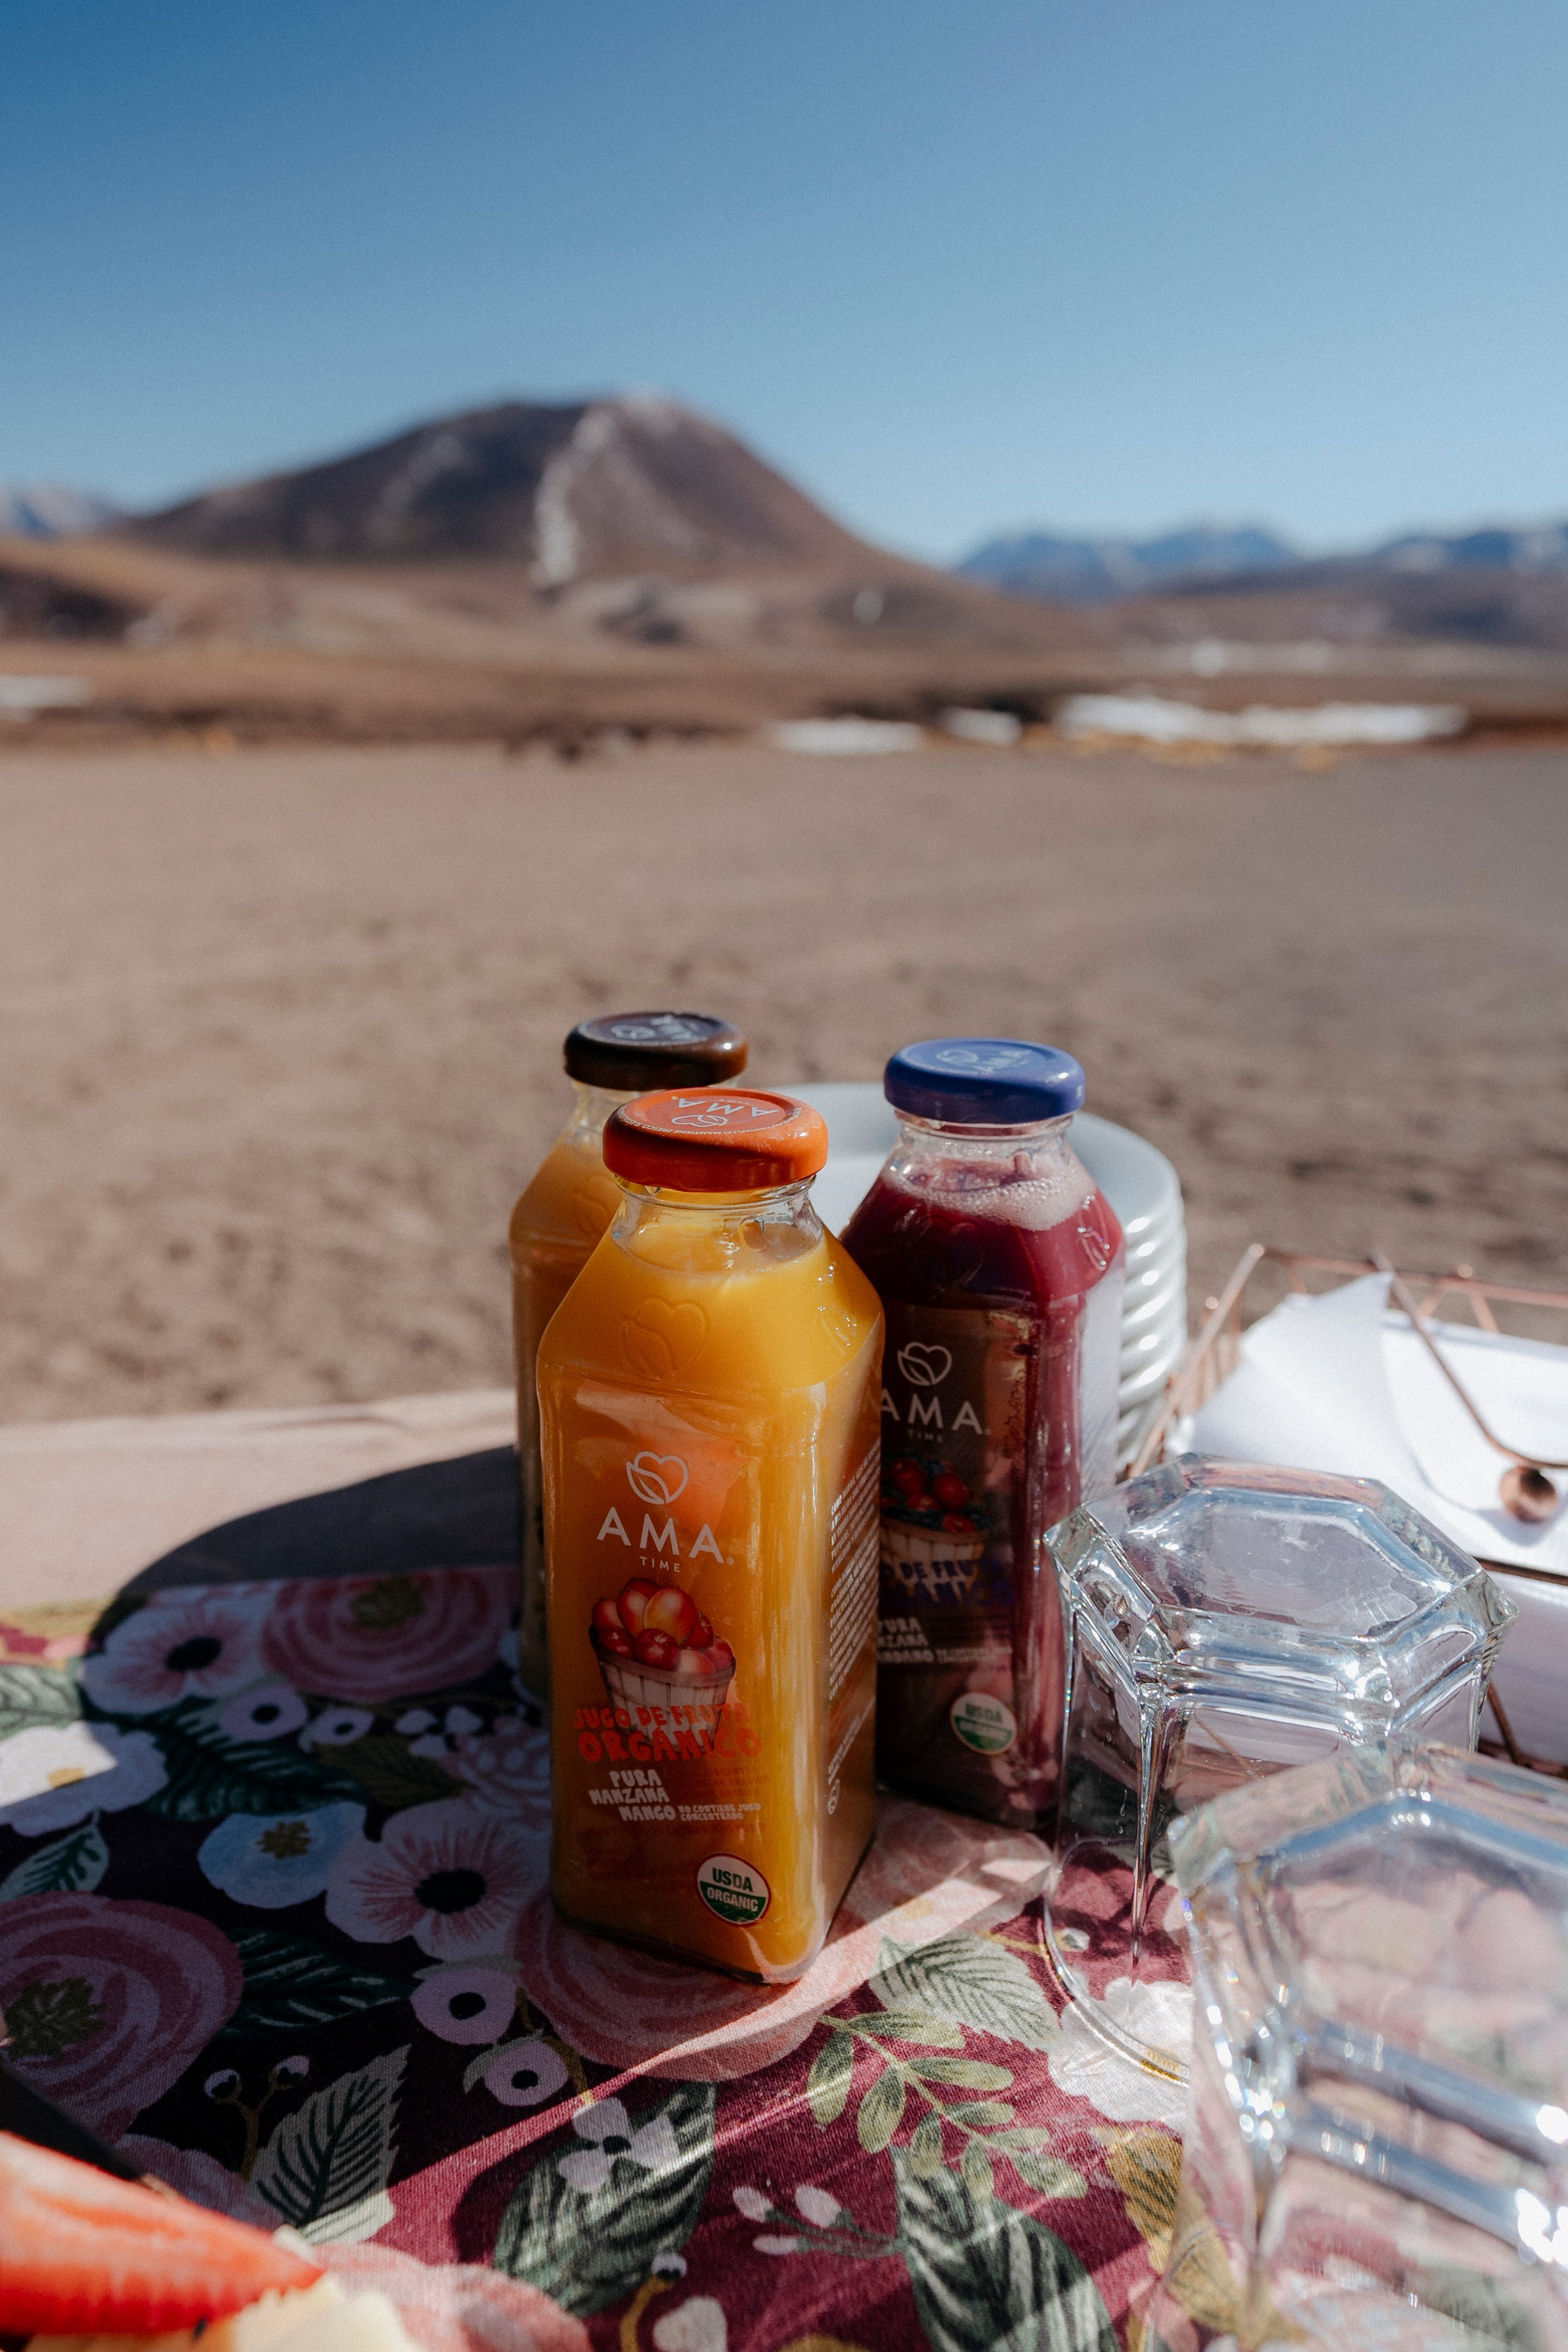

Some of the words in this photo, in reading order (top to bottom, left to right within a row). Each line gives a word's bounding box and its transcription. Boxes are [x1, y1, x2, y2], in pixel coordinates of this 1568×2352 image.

[678, 1098, 780, 1117] AMA
[642, 1124, 673, 1133] FRESCO
[596, 1506, 725, 1564] AMA
[639, 1556, 681, 1573] TIME
[574, 1707, 630, 1729] JUGO
[636, 1706, 668, 1727] DE
[670, 1703, 750, 1725] FRUTA
[579, 1726, 763, 1763] ORGÁNICO
[609, 1769, 663, 1788] PURA
[588, 1787, 671, 1805] MANZANA
[618, 1805, 676, 1822] MANGO
[678, 1805, 692, 1813] NO
[693, 1804, 736, 1813] CONTIENE
[738, 1802, 762, 1812] JUGO
[681, 1812, 744, 1821] CONCENTRADO
[712, 1867, 753, 1893] USDA
[707, 1887, 758, 1912] ORGANIC
